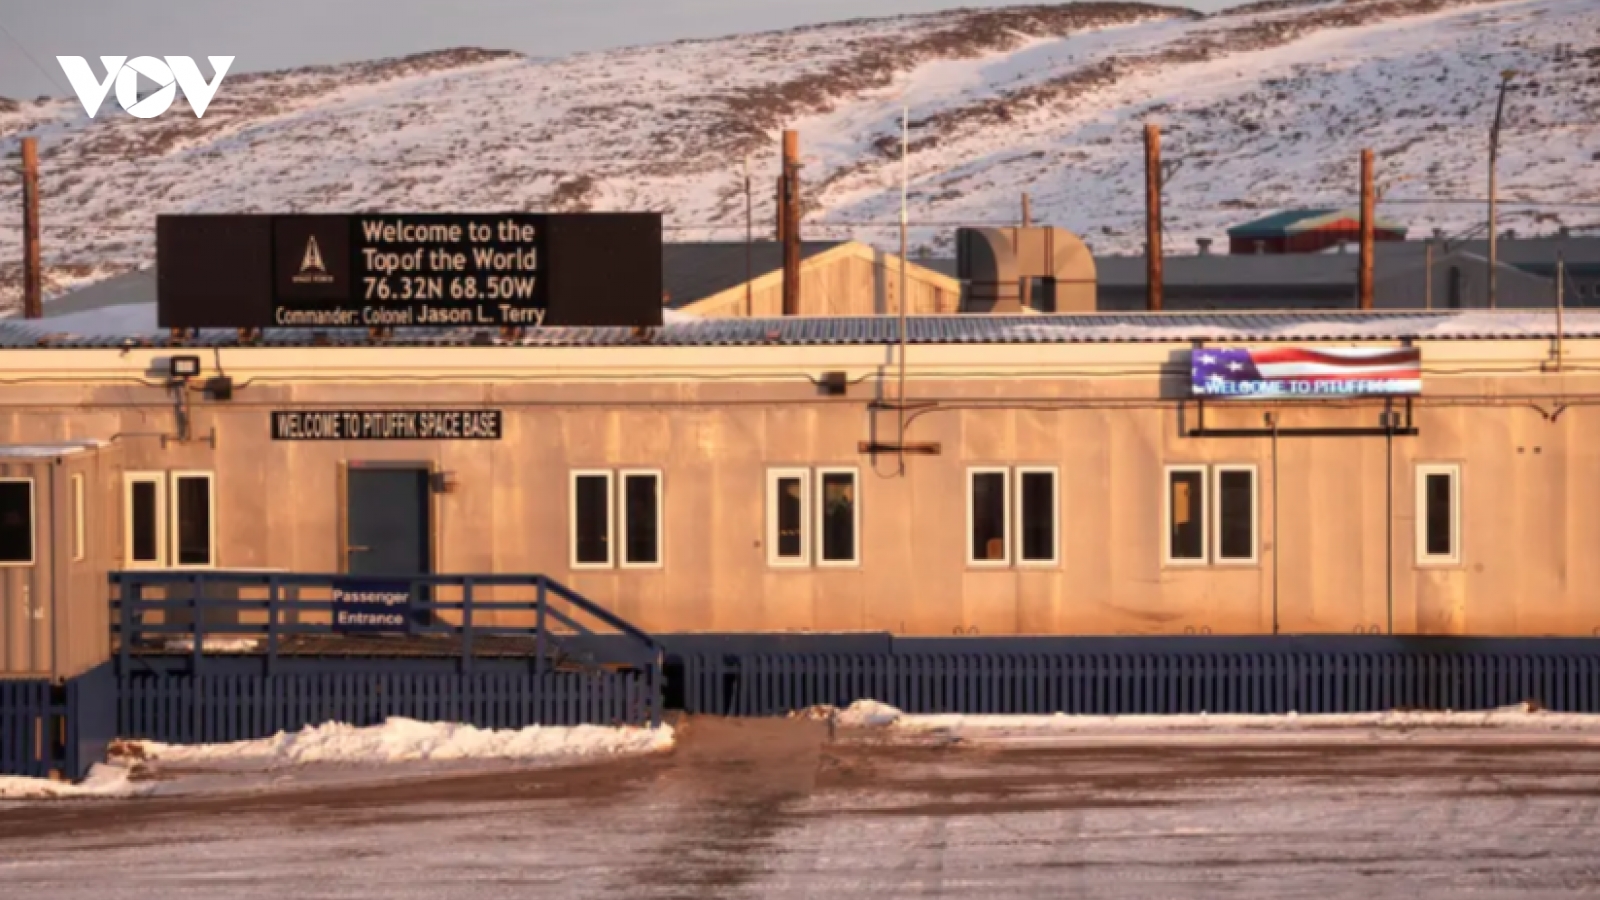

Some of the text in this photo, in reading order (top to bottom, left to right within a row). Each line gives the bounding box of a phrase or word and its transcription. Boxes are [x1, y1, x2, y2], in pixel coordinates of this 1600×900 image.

[362, 218, 535, 243] Welcome to the
[429, 247, 466, 271] the
[471, 247, 537, 271] World
[363, 276, 535, 299] 76.32N 68.50W
[275, 303, 546, 327] Commander: Colonel Jason L. Terry
[1205, 380, 1286, 395] WELCOME
[1290, 380, 1310, 395] TO
[278, 413, 341, 438] WELCOME
[344, 413, 360, 438] TO
[419, 413, 460, 438] SPACE
[463, 413, 497, 438] BASE
[333, 589, 409, 607] Passenger
[338, 611, 404, 625] Entrance
